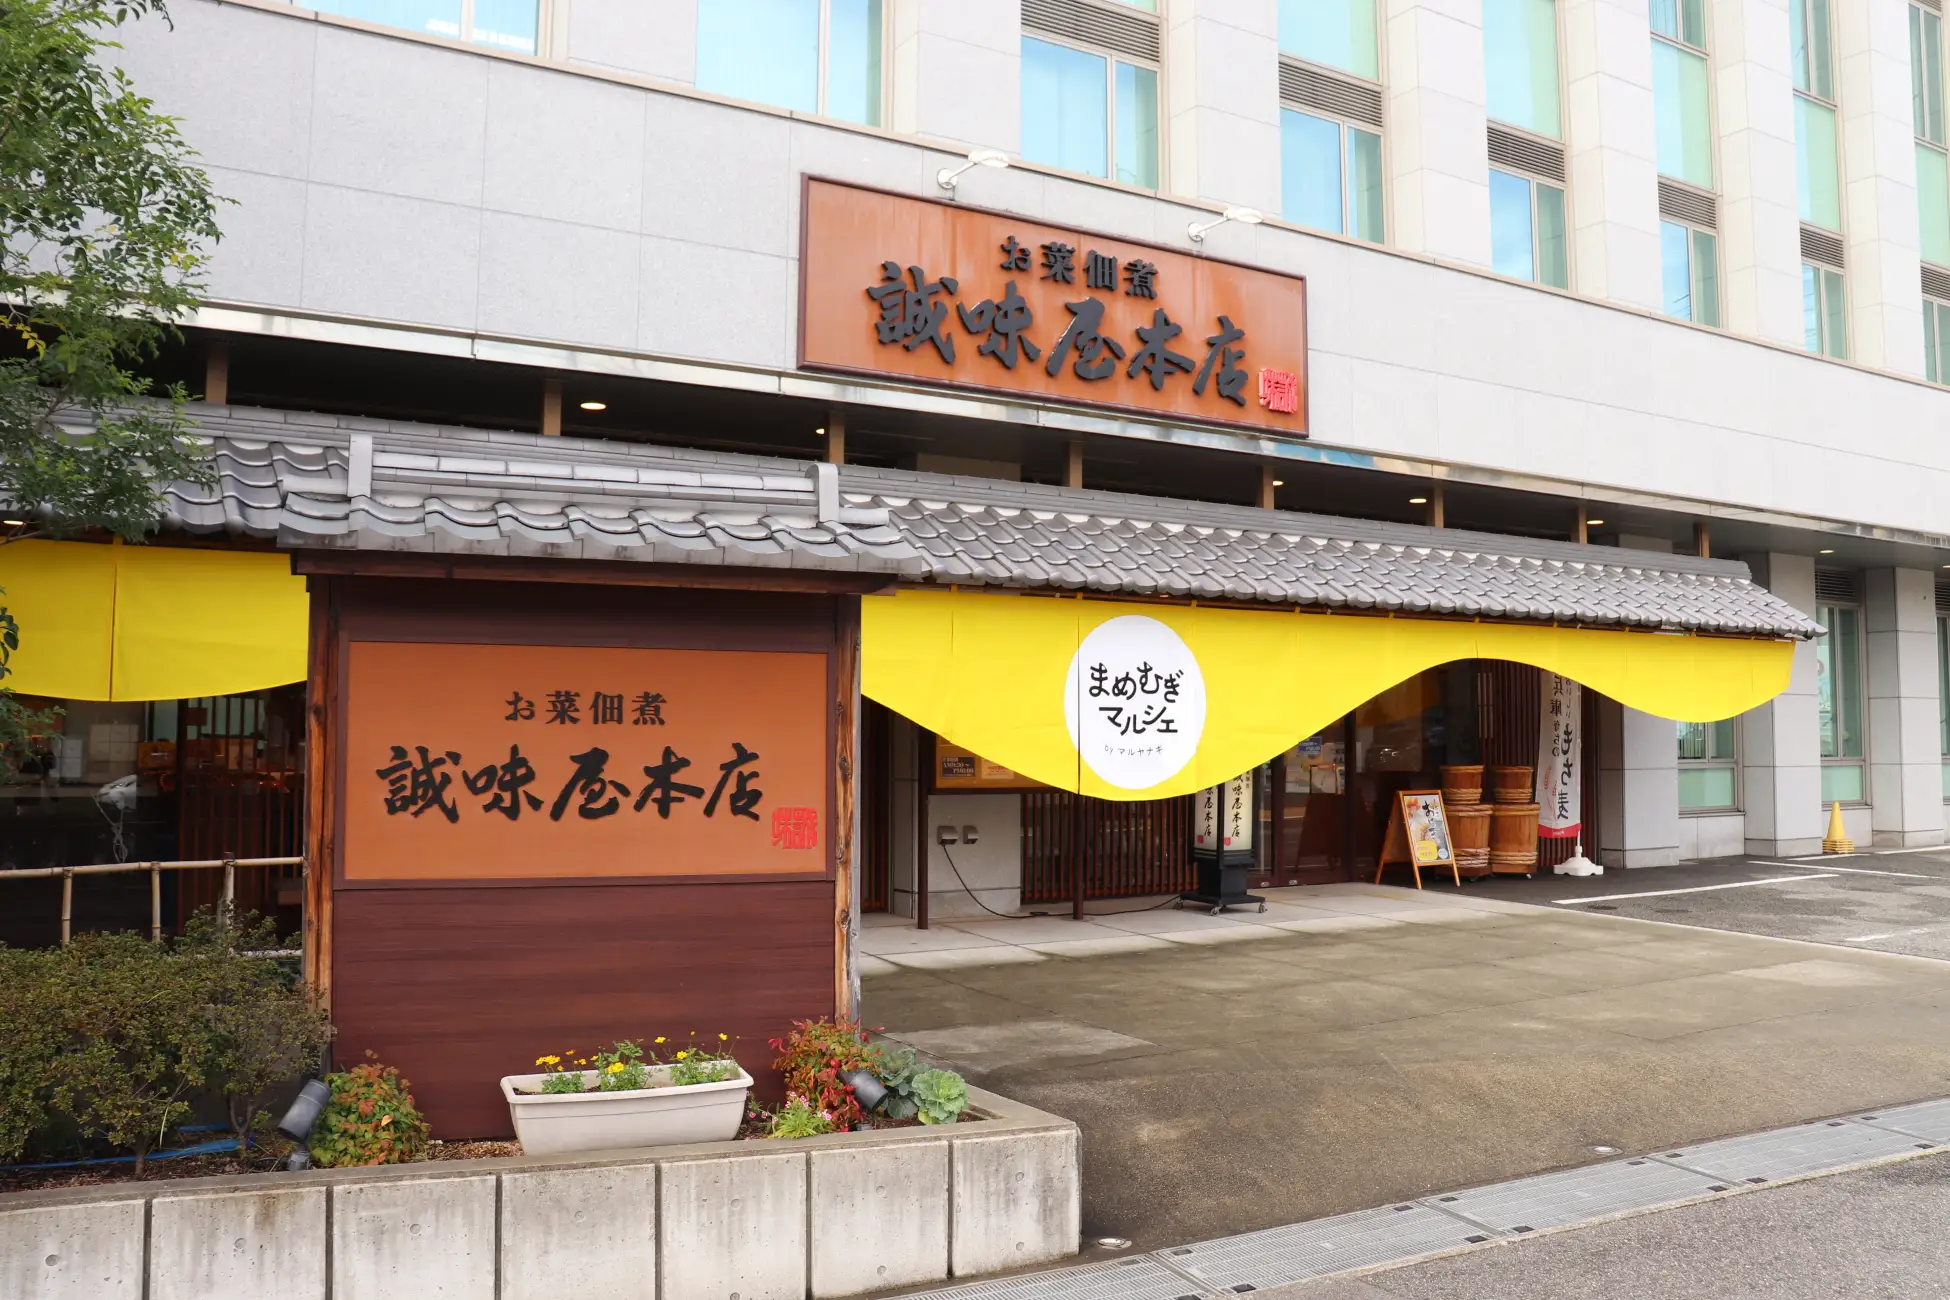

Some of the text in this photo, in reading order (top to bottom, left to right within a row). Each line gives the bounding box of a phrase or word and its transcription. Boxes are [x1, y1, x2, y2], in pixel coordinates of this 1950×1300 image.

[1000, 234, 1159, 301] お菜佃煮
[866, 260, 1248, 406] 誠味屋本店
[1088, 661, 1184, 704] まめむぎ
[504, 691, 668, 727] お菜佃煮
[1099, 705, 1178, 736] マルシェ
[1104, 743, 1163, 756] by マルヤナギ
[376, 743, 764, 823] 誠味屋本店
